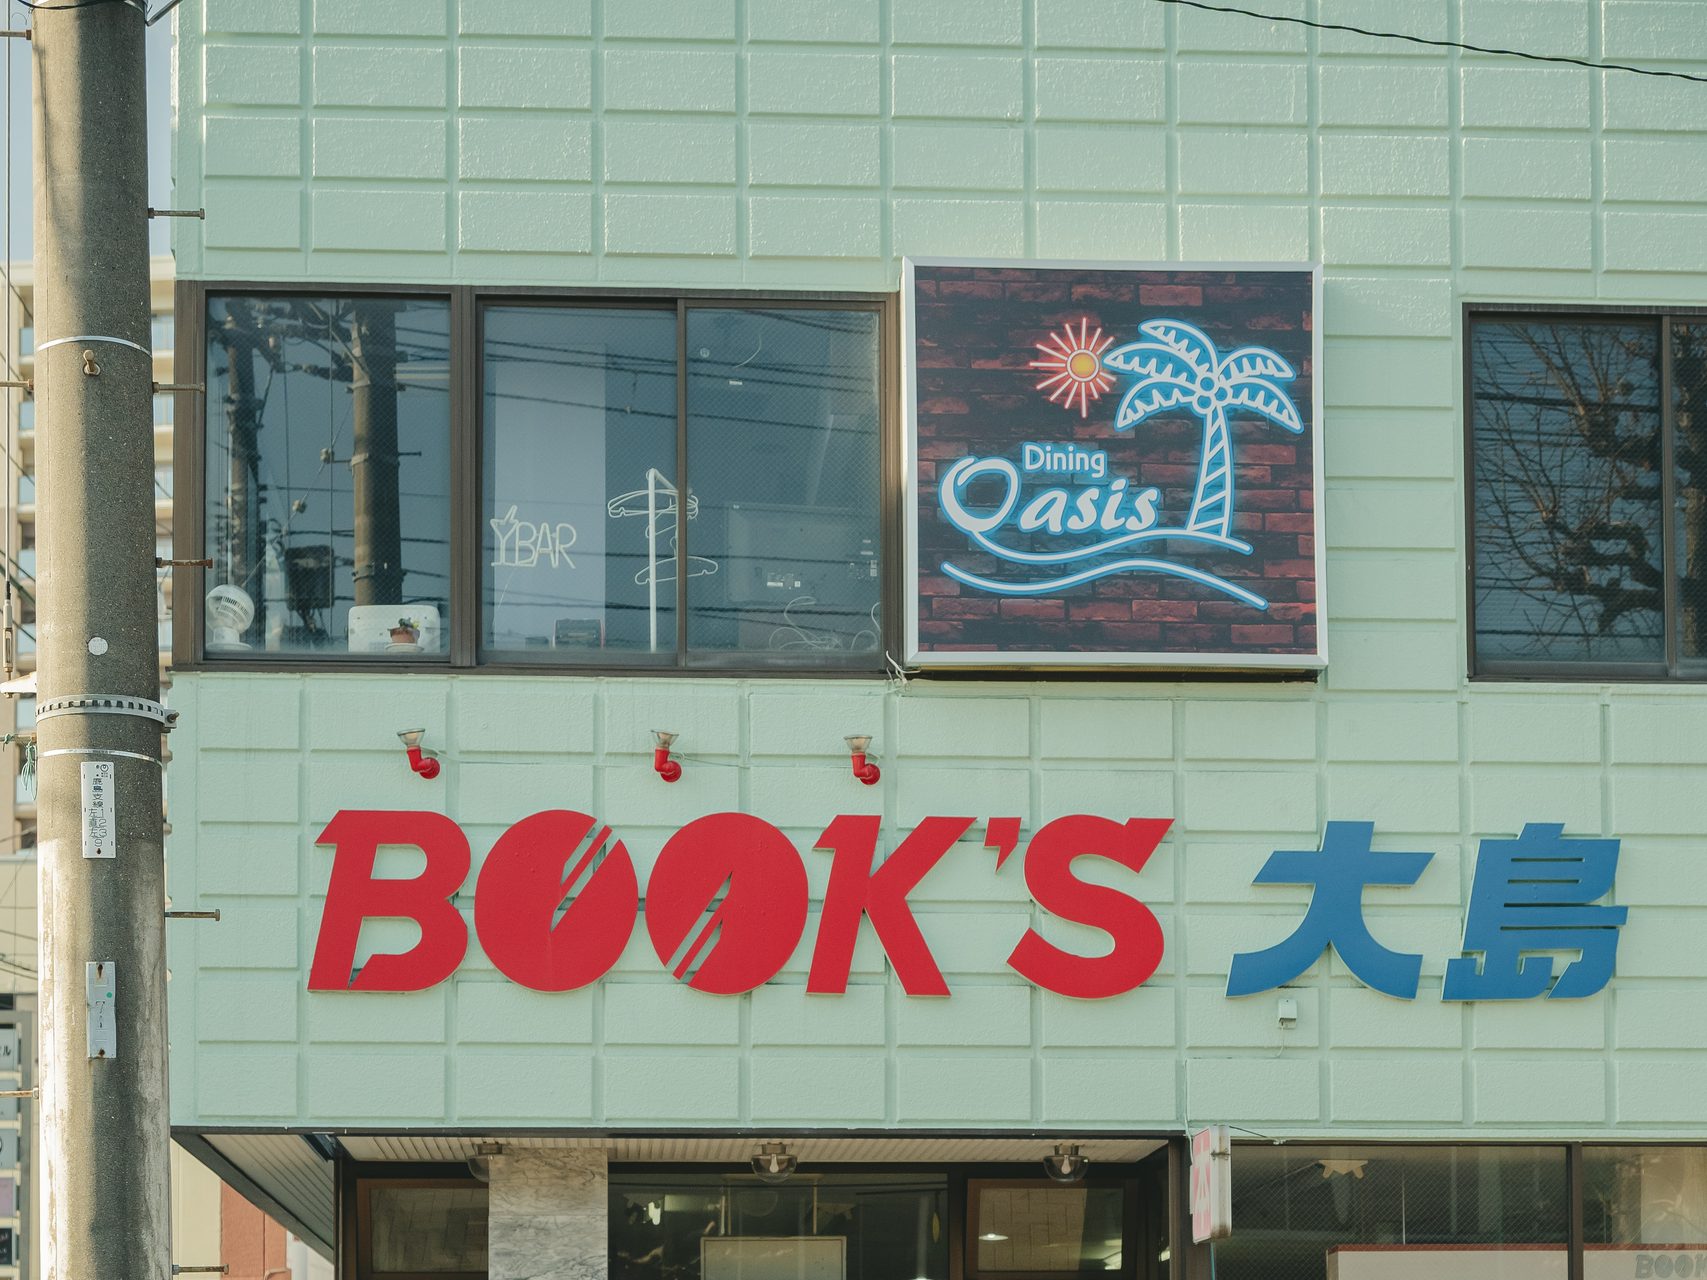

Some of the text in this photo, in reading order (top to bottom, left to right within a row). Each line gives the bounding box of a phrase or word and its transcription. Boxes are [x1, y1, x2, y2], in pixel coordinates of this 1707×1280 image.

[940, 457, 1160, 534] Oasis
[1023, 445, 1106, 478] Dining
[307, 808, 1630, 1002] BOOK'S 大島
